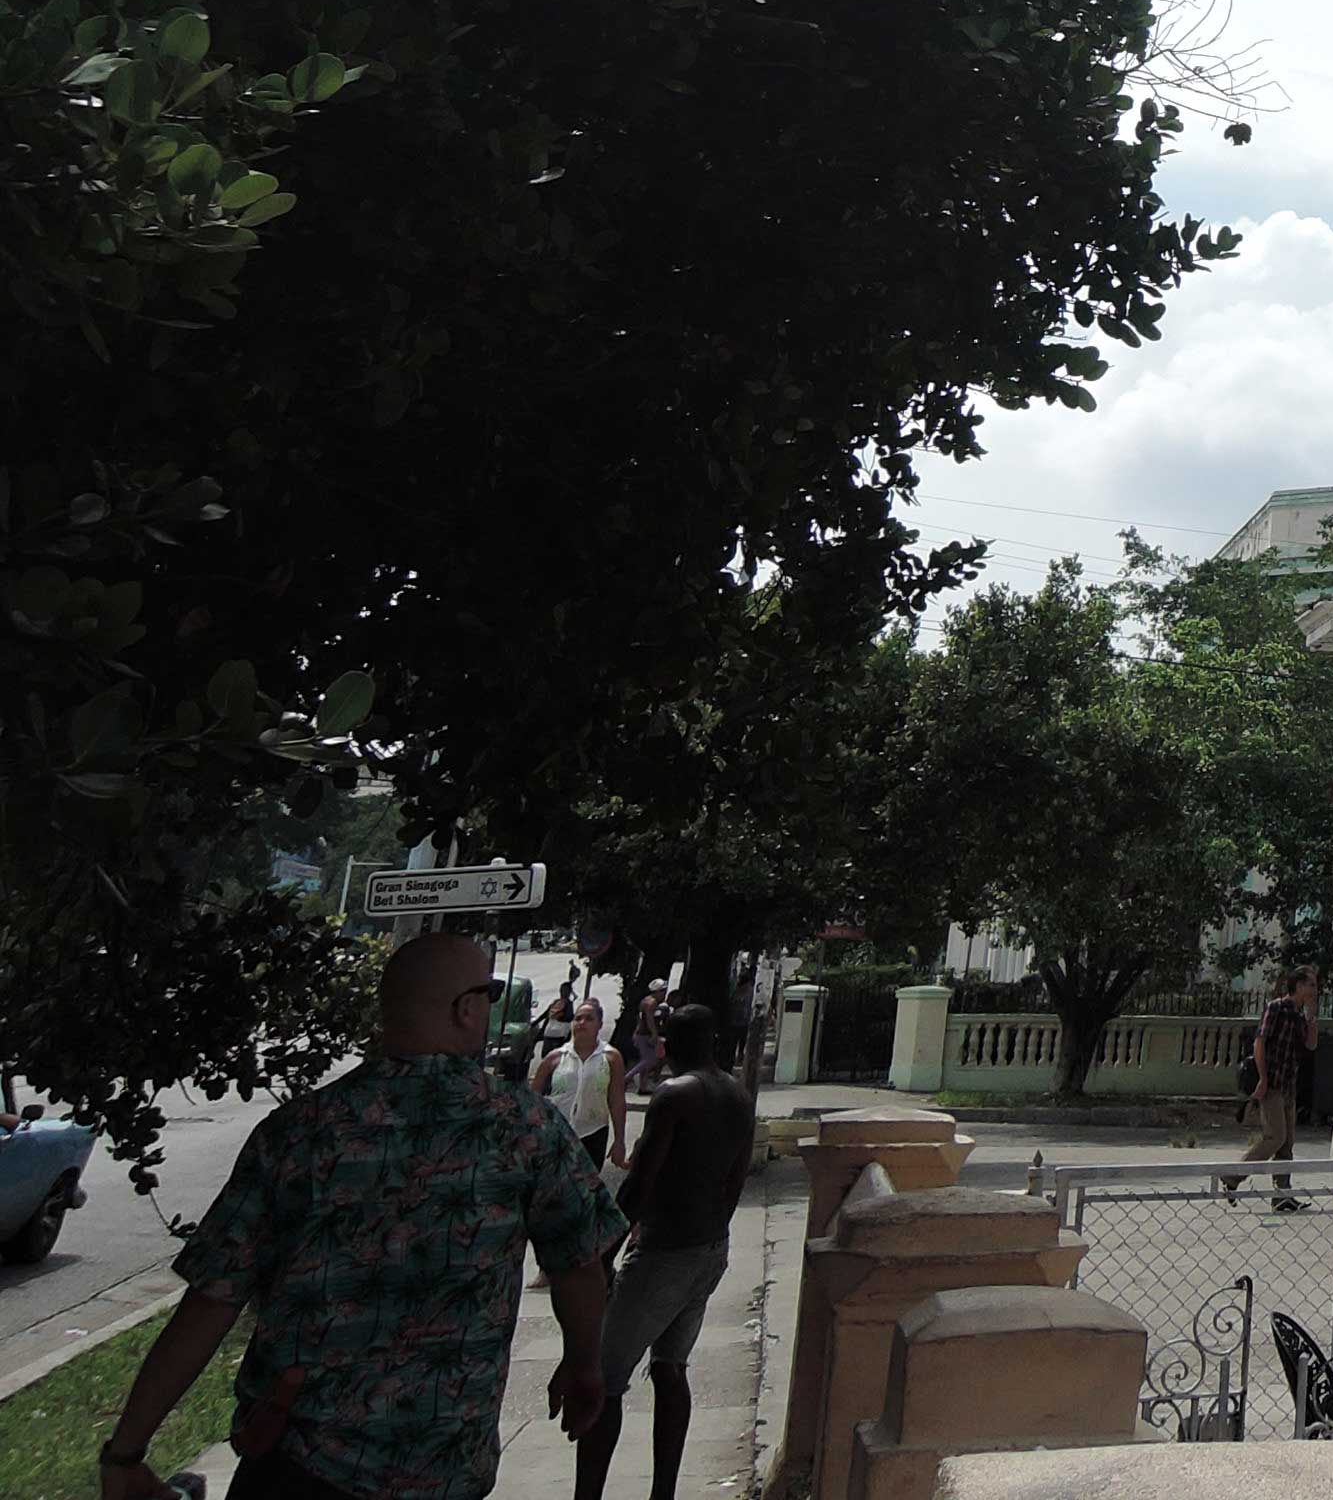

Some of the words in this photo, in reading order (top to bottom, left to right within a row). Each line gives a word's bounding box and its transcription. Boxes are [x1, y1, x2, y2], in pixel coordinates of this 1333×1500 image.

[375, 882, 402, 893] Gran
[406, 879, 459, 892] Sinagoga
[373, 895, 393, 906] Bet
[397, 893, 440, 905] Shalom
